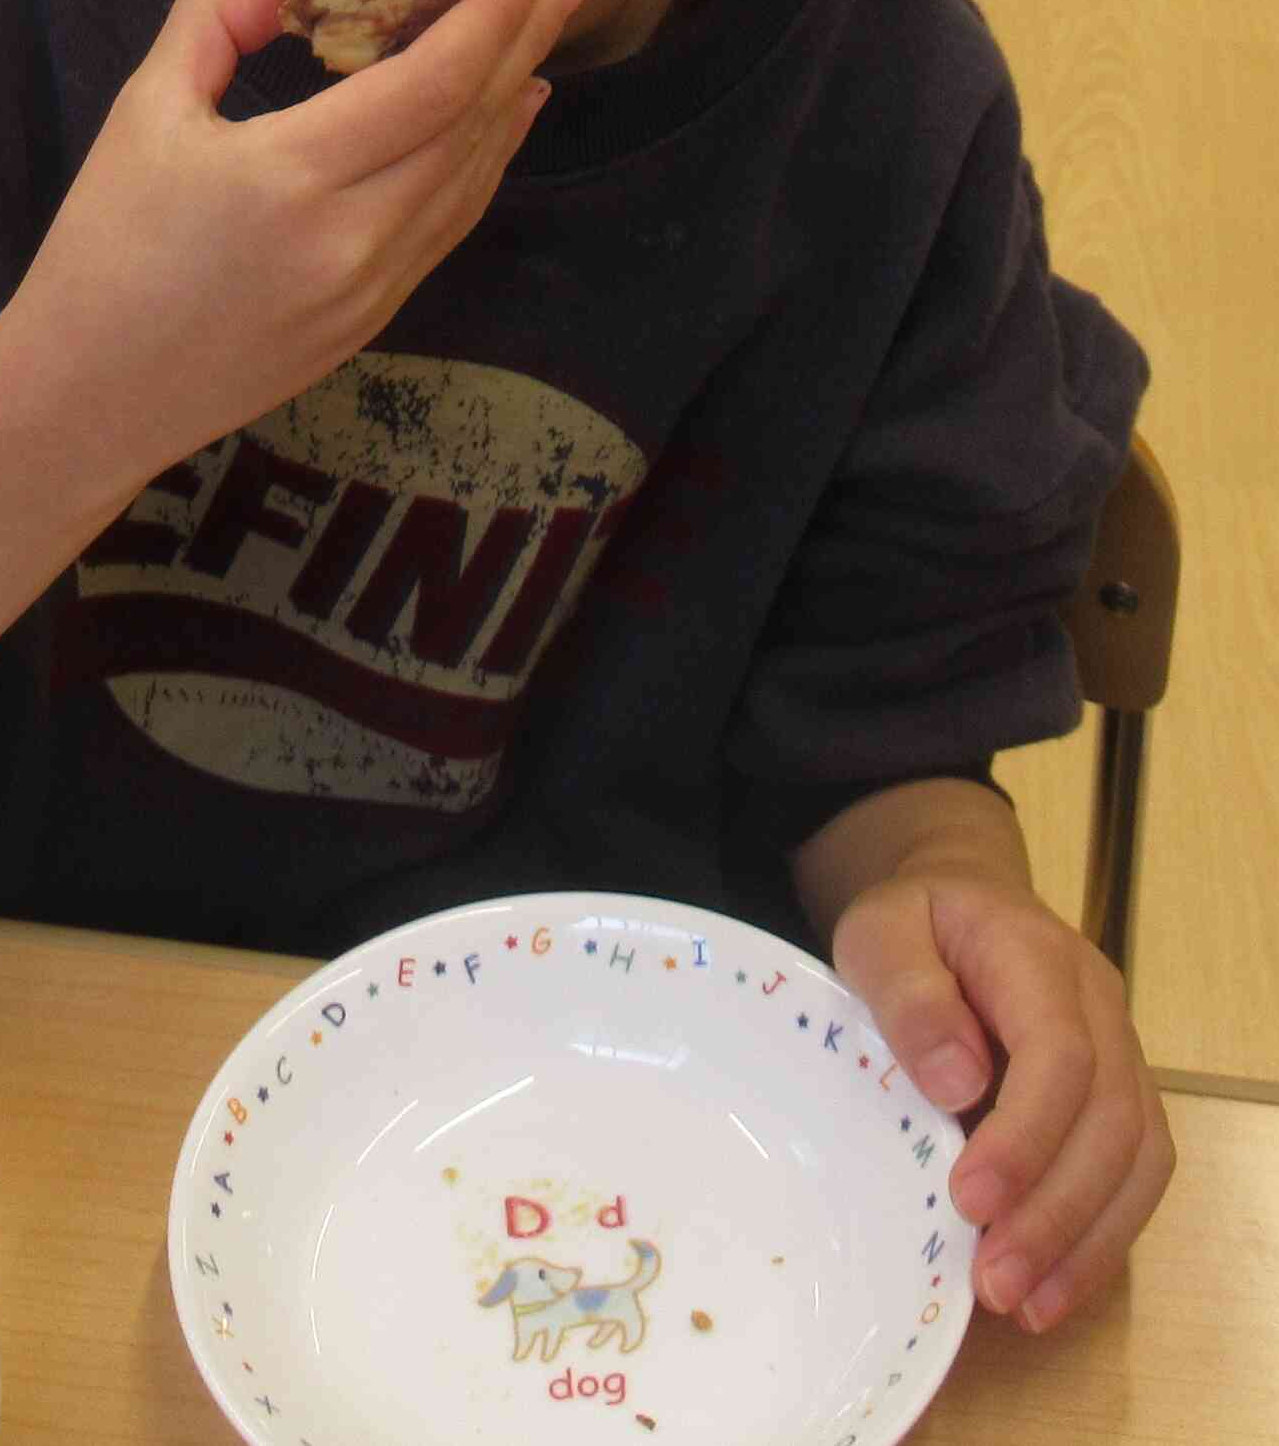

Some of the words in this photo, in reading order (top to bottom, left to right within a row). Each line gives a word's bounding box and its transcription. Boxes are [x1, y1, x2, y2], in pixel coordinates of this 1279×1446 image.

[80, 438, 630, 676] EFINI
[531, 926, 552, 954] G
[692, 939, 707, 966] I
[397, 957, 416, 987] E
[464, 953, 482, 984] F
[610, 943, 635, 974] H
[762, 970, 787, 995] J
[322, 1002, 346, 1027] D
[824, 1020, 843, 1053] K
[277, 1055, 293, 1085] C
[227, 1097, 247, 1125] B
[912, 1134, 935, 1168] M
[213, 1171, 233, 1194] A
[505, 1195, 550, 1238] D
[597, 1195, 625, 1228] d
[922, 1230, 945, 1265] N
[549, 1367, 626, 1405] dog
